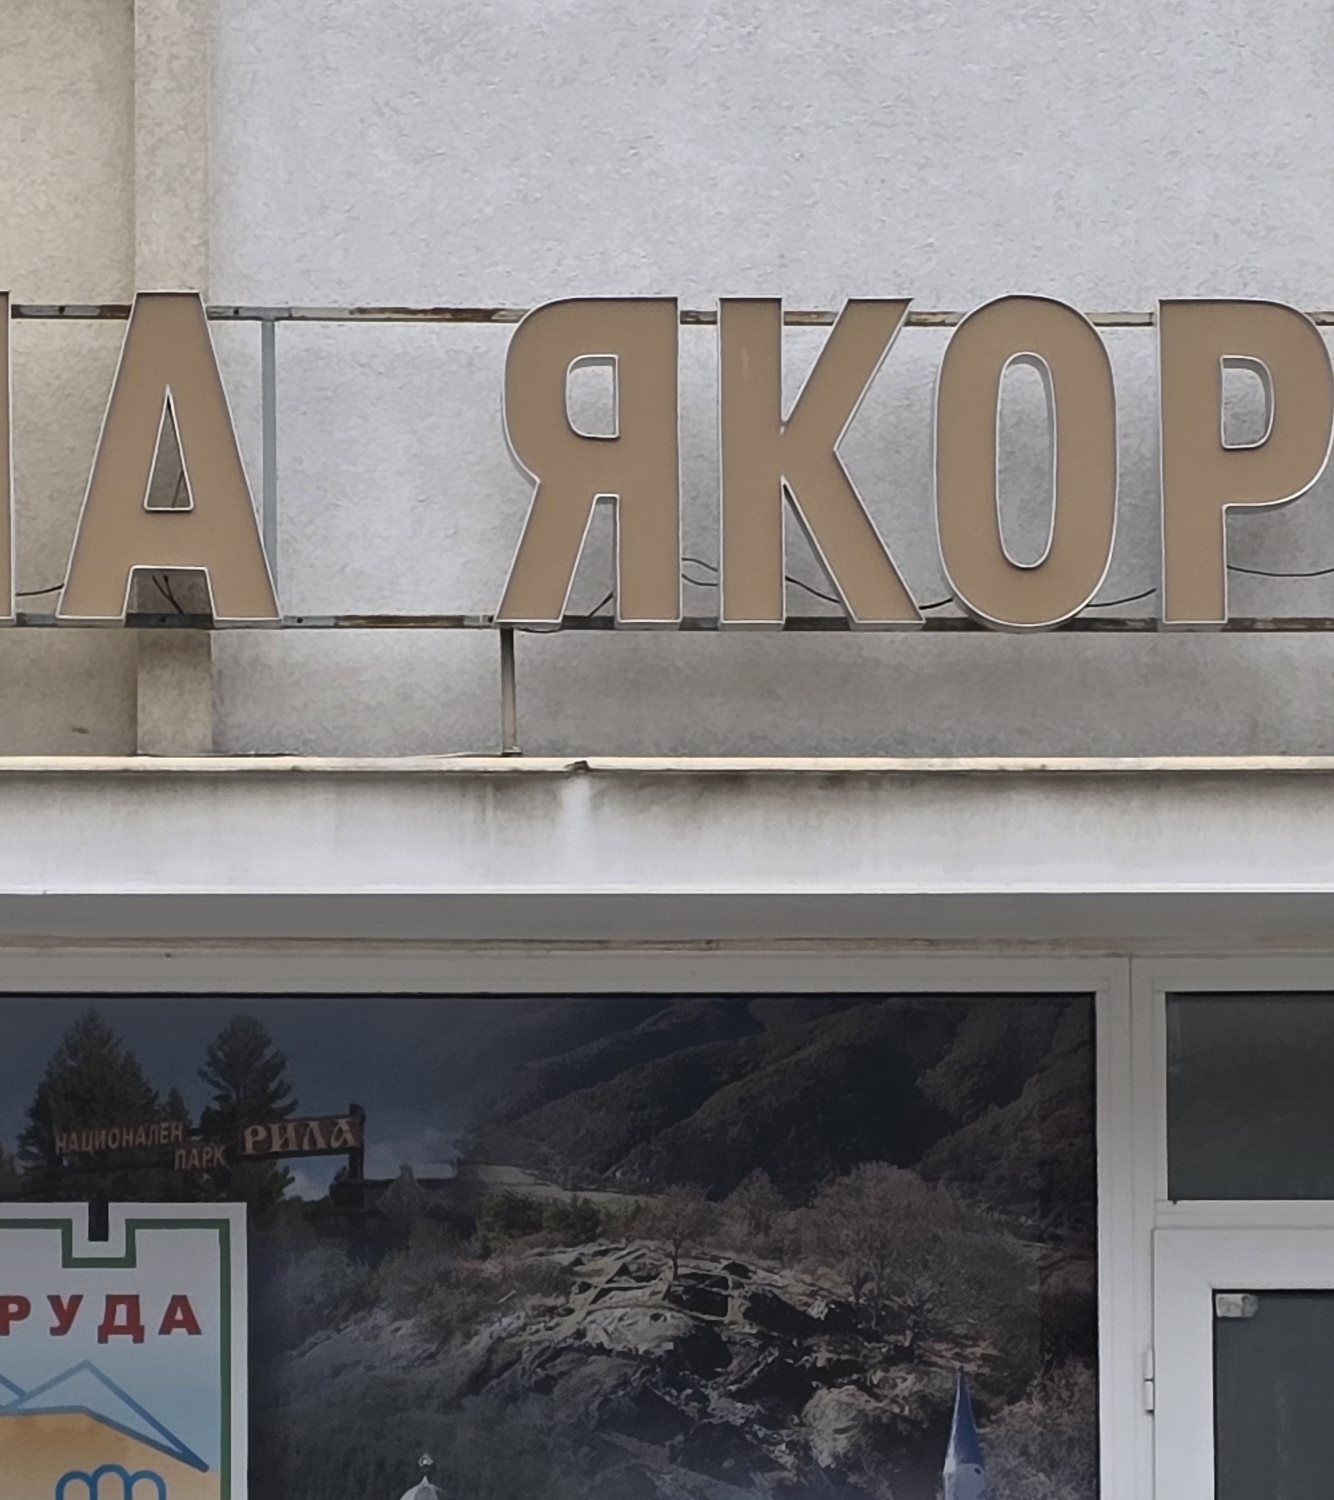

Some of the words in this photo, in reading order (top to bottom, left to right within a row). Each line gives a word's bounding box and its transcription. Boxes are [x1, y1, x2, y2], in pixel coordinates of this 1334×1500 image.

[54, 1121, 184, 1156] НАЦИОНАЛЕН
[242, 1117, 359, 1156] РИЛА
[173, 1144, 227, 1171] ПАРК
